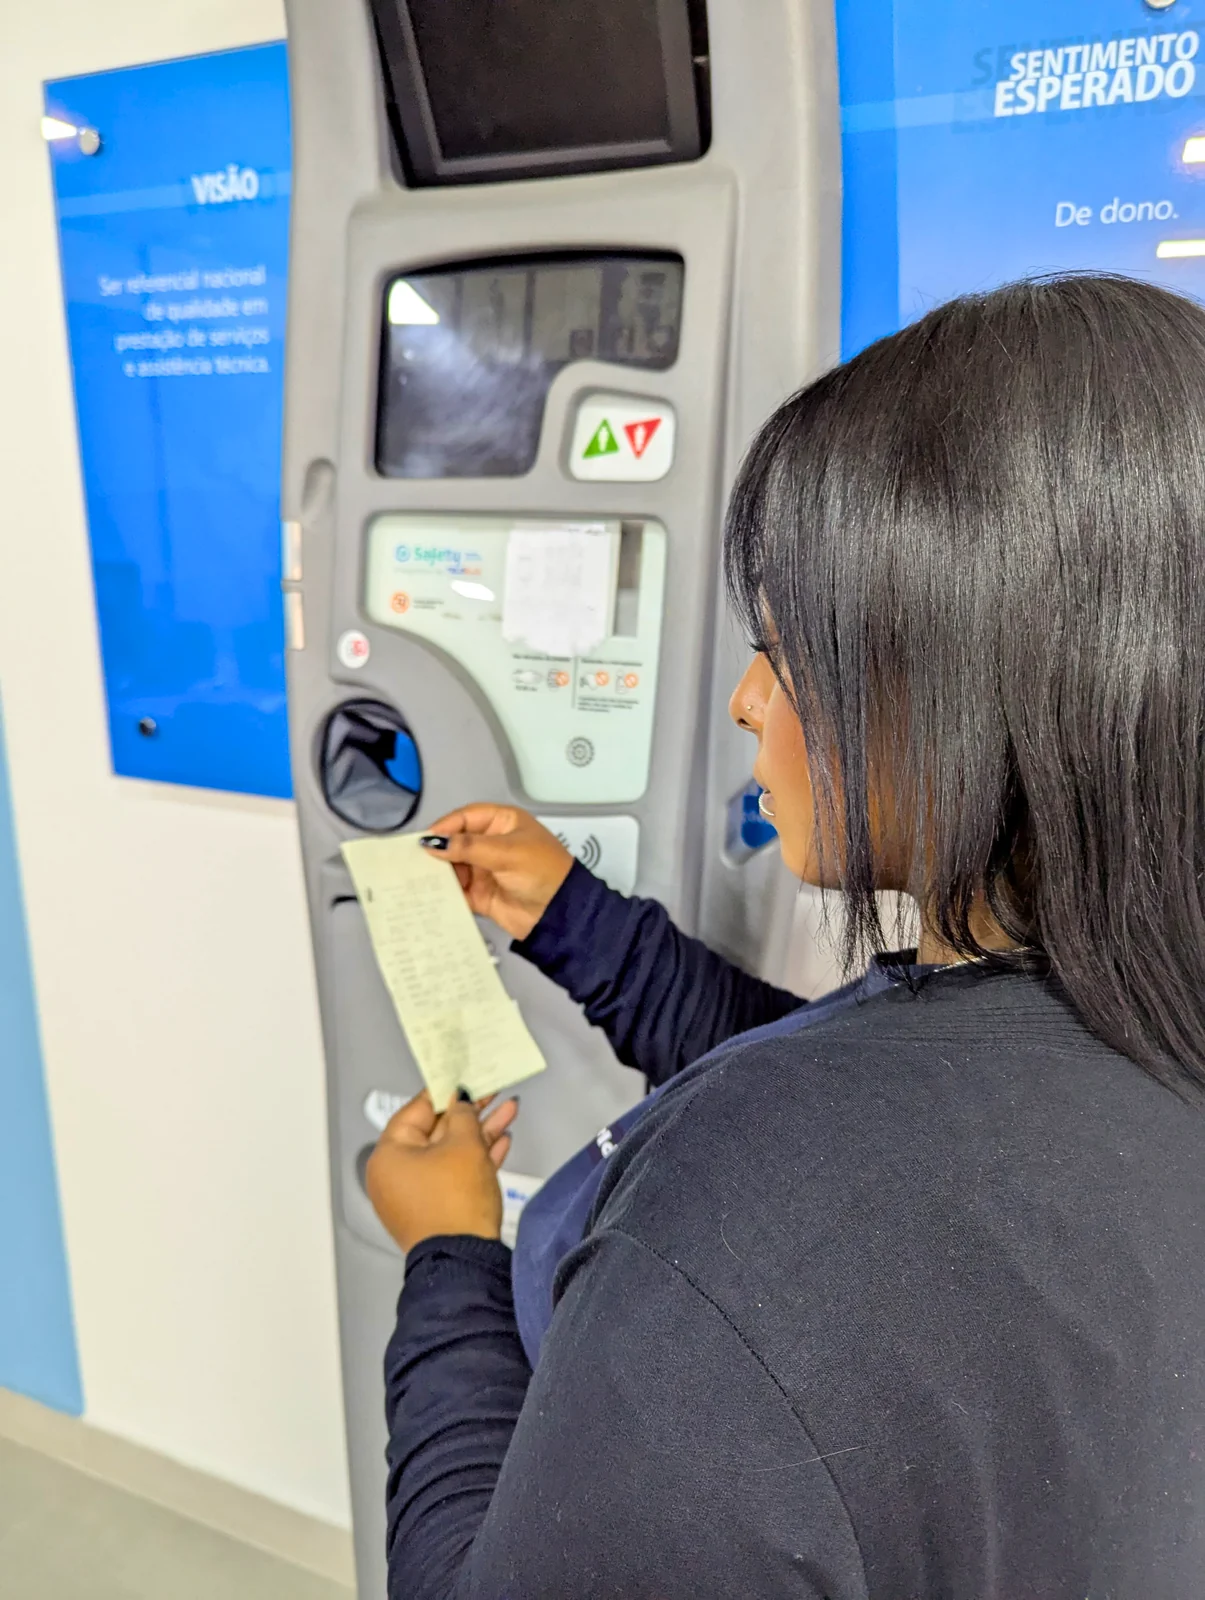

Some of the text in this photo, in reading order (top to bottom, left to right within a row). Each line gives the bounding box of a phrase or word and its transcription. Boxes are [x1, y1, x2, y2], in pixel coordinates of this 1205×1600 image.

[1009, 30, 1200, 81] SENTIMENTO
[994, 60, 1196, 118] ESPERADO
[191, 164, 259, 204] VISÃO
[1055, 197, 1179, 227] De dono.
